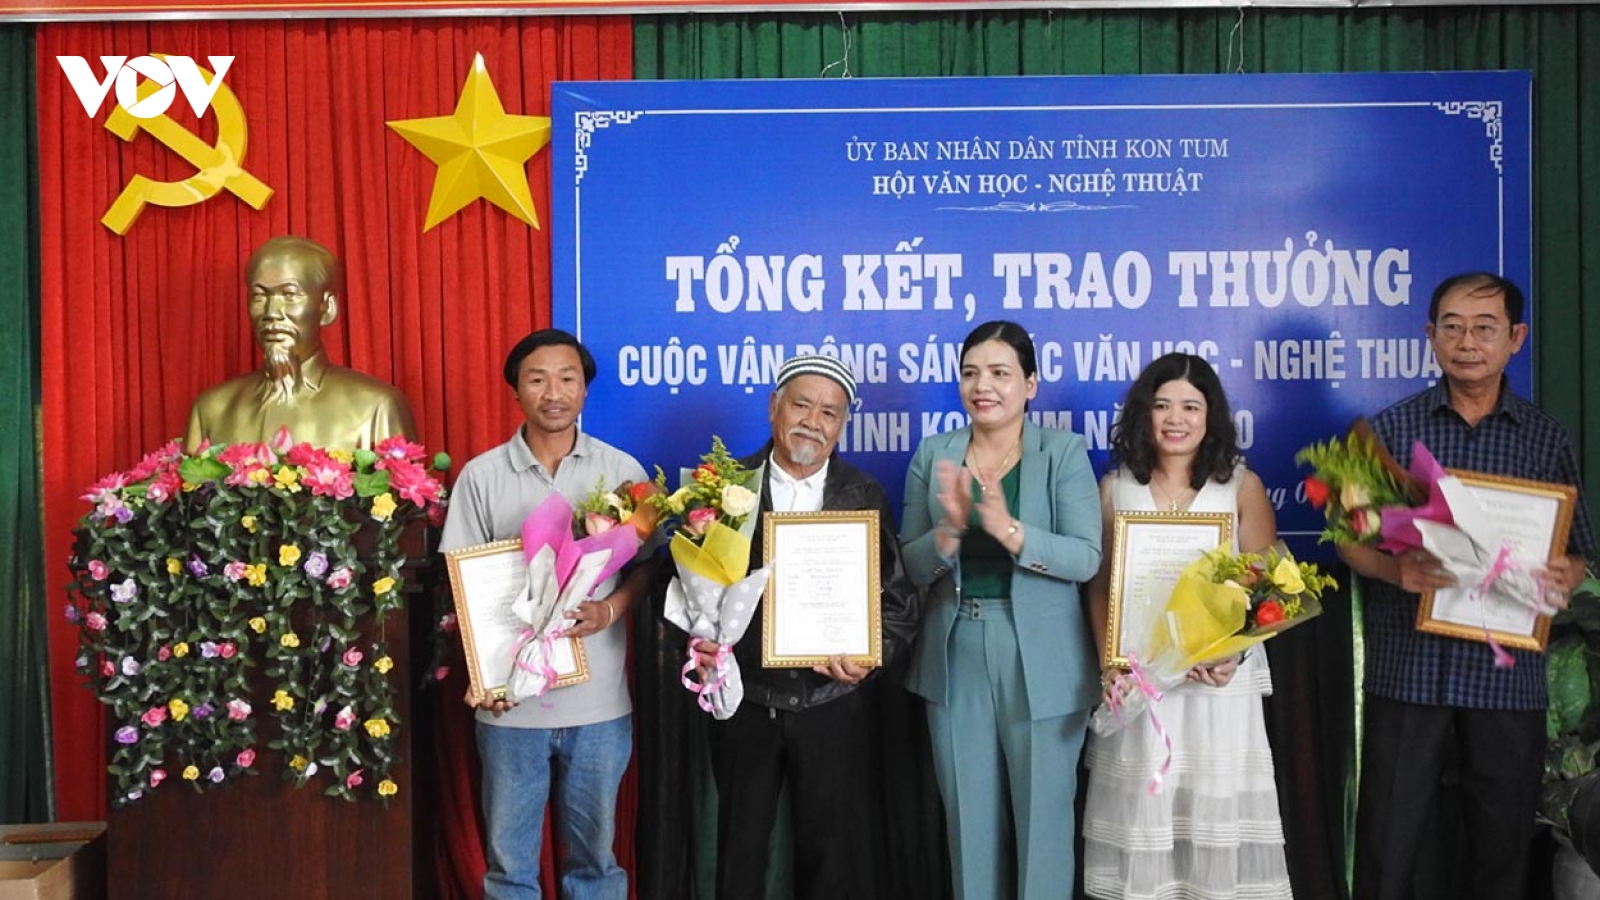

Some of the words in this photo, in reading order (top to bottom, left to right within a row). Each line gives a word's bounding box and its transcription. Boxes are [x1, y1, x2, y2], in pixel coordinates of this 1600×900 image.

[846, 136, 876, 161] ỦY
[884, 141, 929, 161] BAN
[937, 136, 1001, 161] NHÂN
[1009, 136, 1055, 160] DÂN
[1062, 135, 1118, 160] TỈNH
[1125, 138, 1172, 159] KON
[1180, 138, 1229, 158] TUM
[873, 170, 915, 199] HỘI
[923, 170, 971, 195] VĂN
[978, 174, 1027, 198] HỌC
[1048, 168, 1116, 197] NGHỆ
[1123, 168, 1203, 197] THUẬT
[666, 236, 825, 313] TỔNG
[842, 237, 975, 321] KẾT,
[993, 250, 1152, 309] TRAO
[1169, 231, 1412, 309] THƯỞNG
[619, 337, 707, 394] CUỘC
[718, 336, 784, 393] VẬN
[899, 334, 964, 383] SÁN
[1073, 333, 1141, 382] VĂN
[1254, 332, 1347, 389] NGHỆ
[1357, 333, 1443, 388] THUẬ
